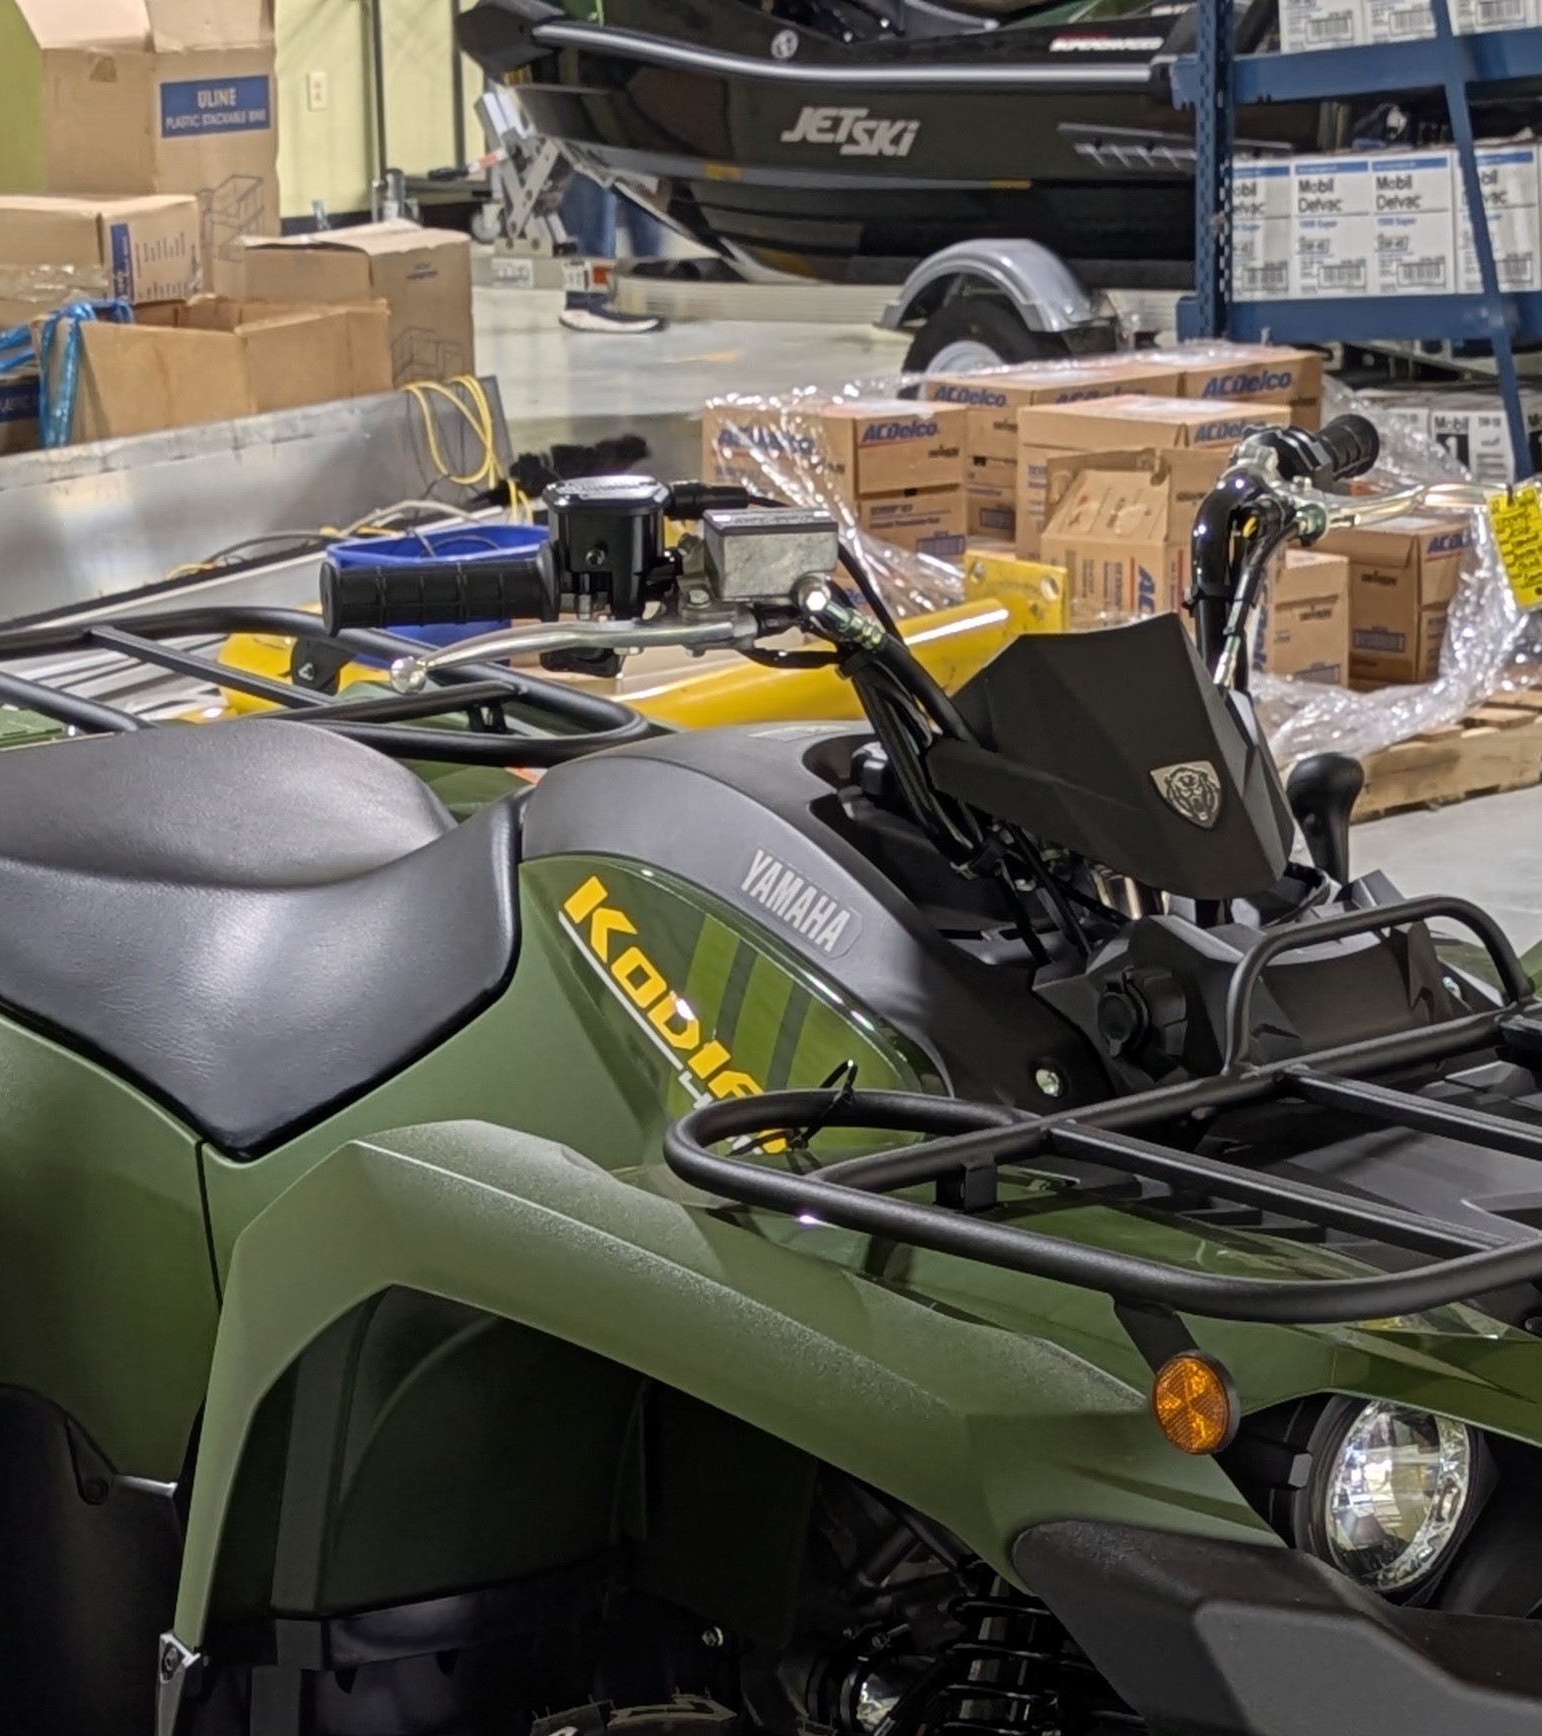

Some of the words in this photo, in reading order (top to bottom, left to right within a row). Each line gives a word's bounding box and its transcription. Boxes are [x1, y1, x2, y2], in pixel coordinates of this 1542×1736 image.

[197, 87, 237, 109] ULINE
[1233, 182, 1258, 198] obil
[1297, 178, 1335, 195] Mobil
[1376, 175, 1413, 192] Mobil
[1232, 201, 1265, 216] elvac
[1297, 198, 1344, 213] Delvac
[1376, 196, 1422, 212] Delvac
[1202, 370, 1294, 399] ACDelco
[935, 386, 1007, 408] ACDelco
[861, 420, 935, 443] ACDelco
[740, 849, 852, 953] YAMAHA
